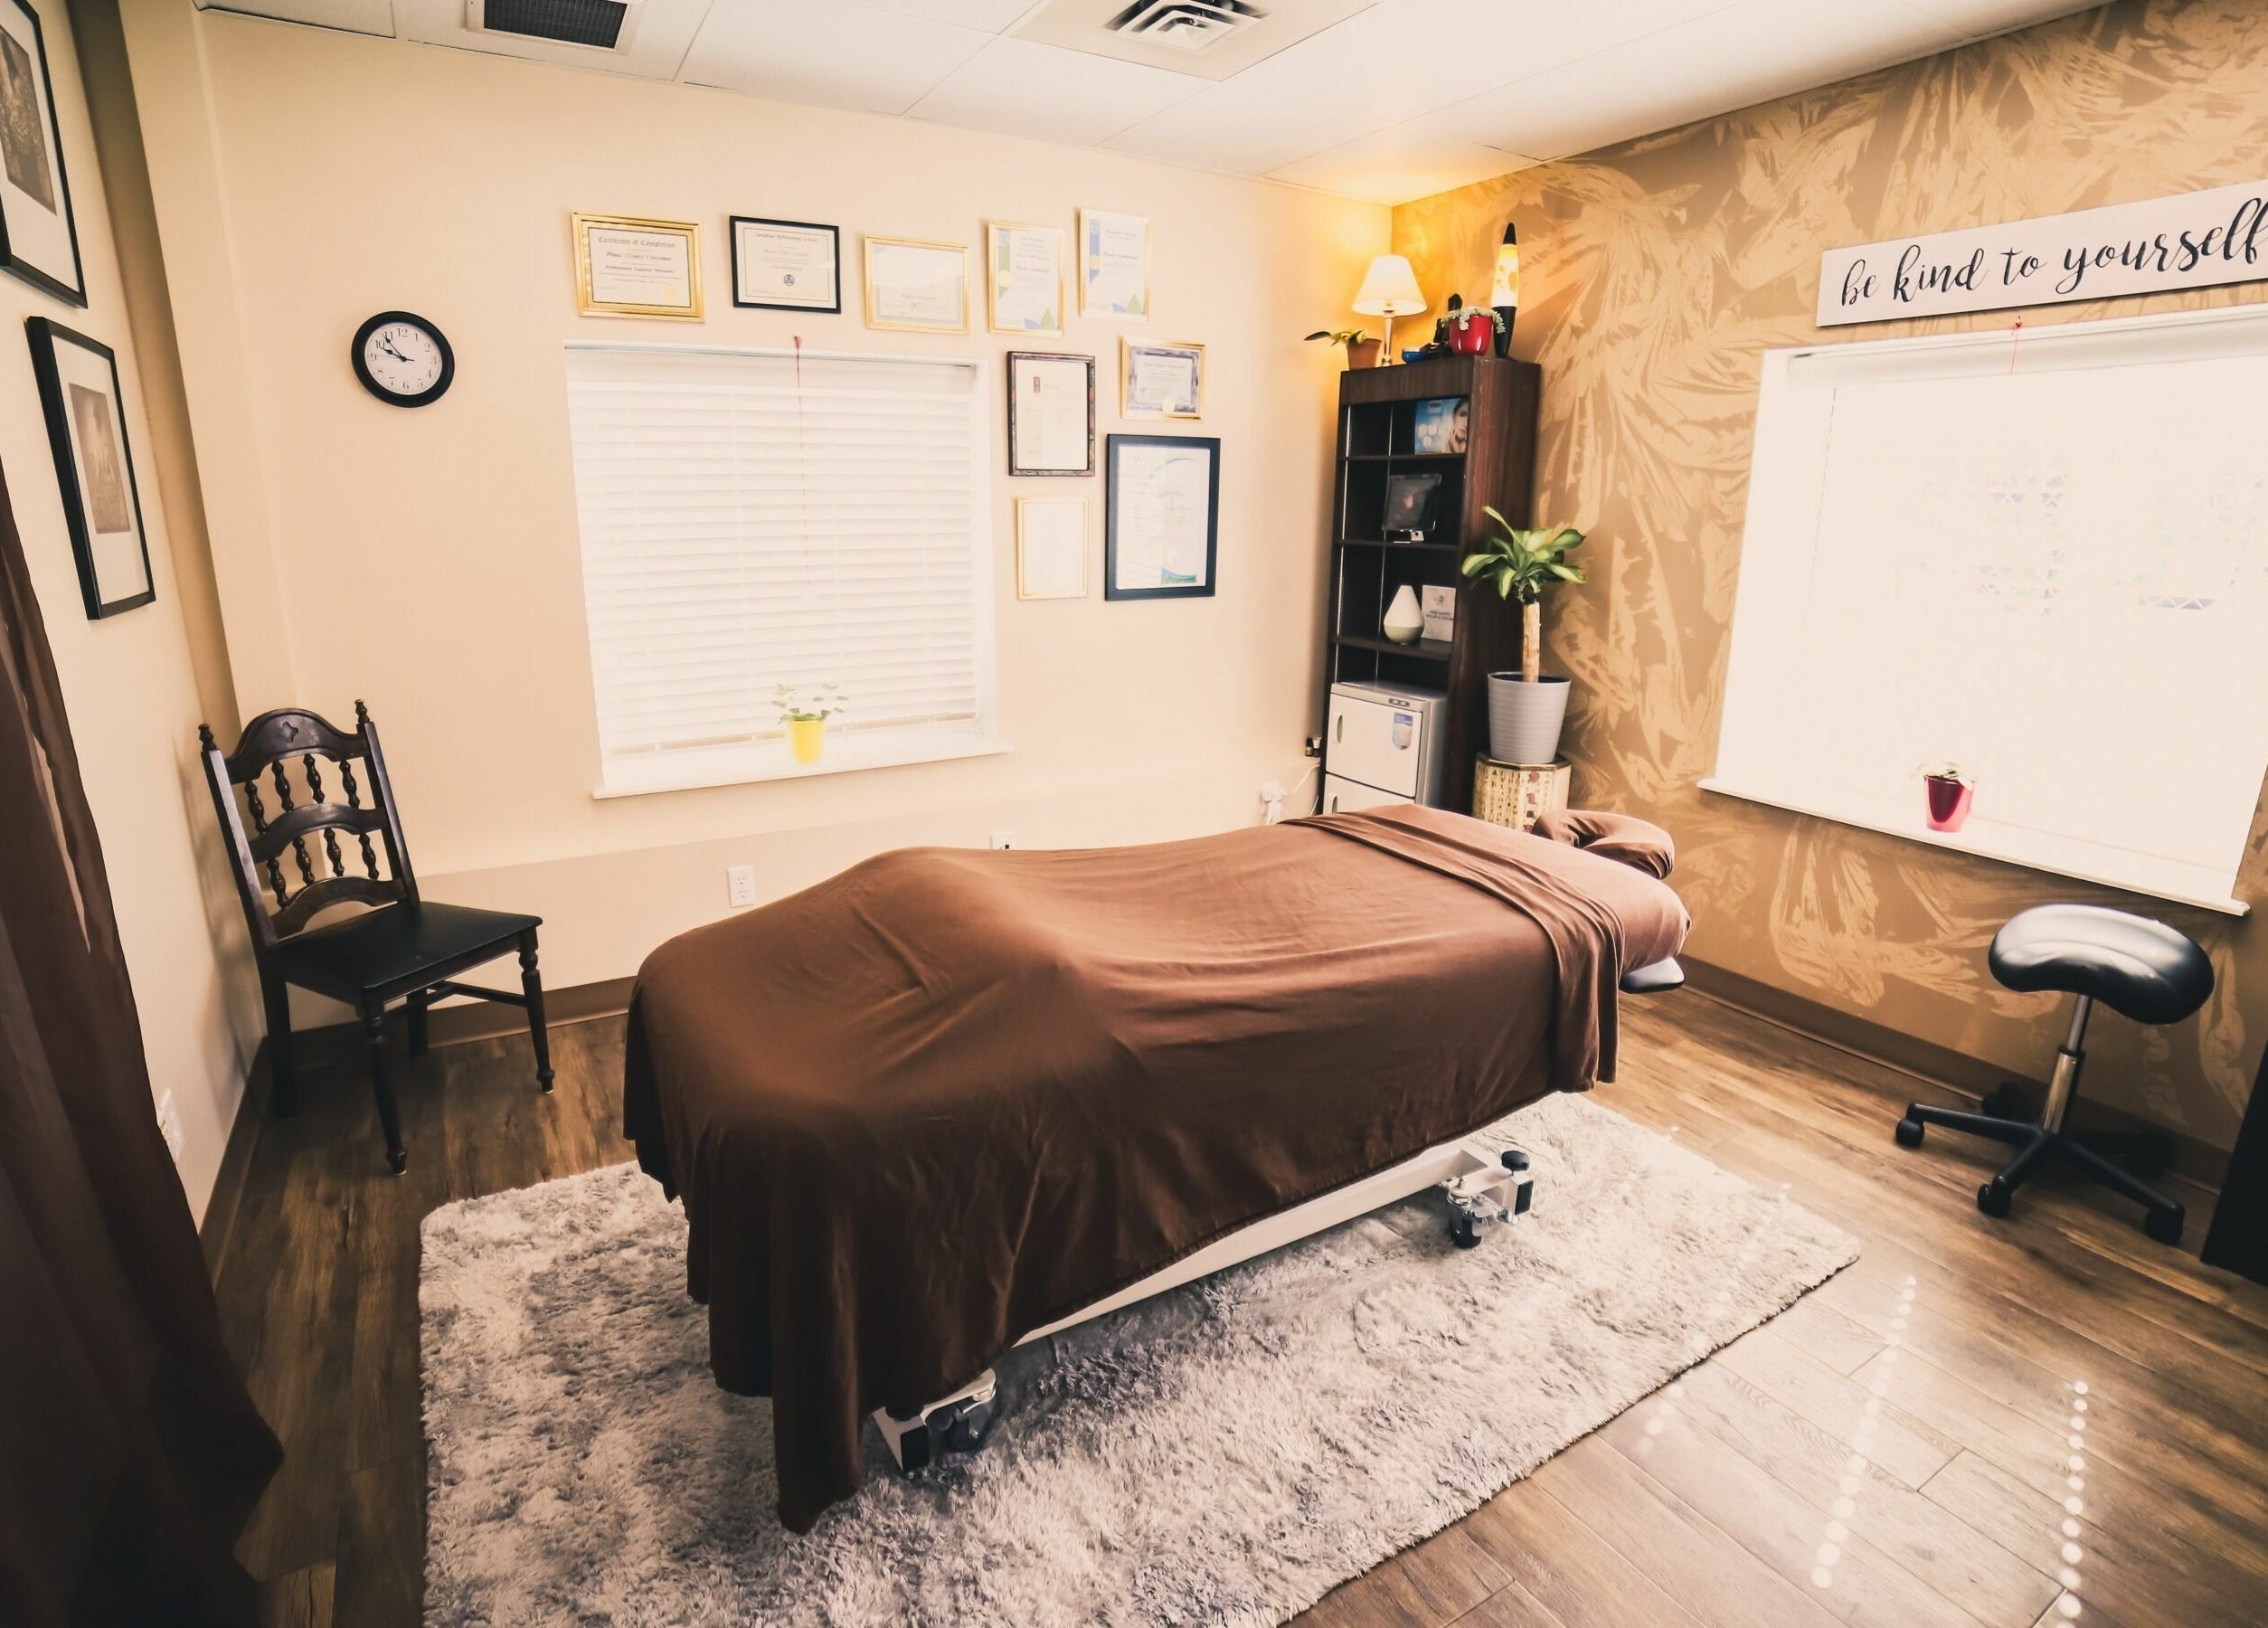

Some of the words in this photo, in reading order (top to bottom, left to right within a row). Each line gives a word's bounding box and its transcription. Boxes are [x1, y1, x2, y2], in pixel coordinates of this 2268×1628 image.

[1841, 259, 1880, 306] be
[1893, 244, 1989, 303] kind
[1999, 247, 2047, 286] to
[2055, 197, 2268, 295] yourself
